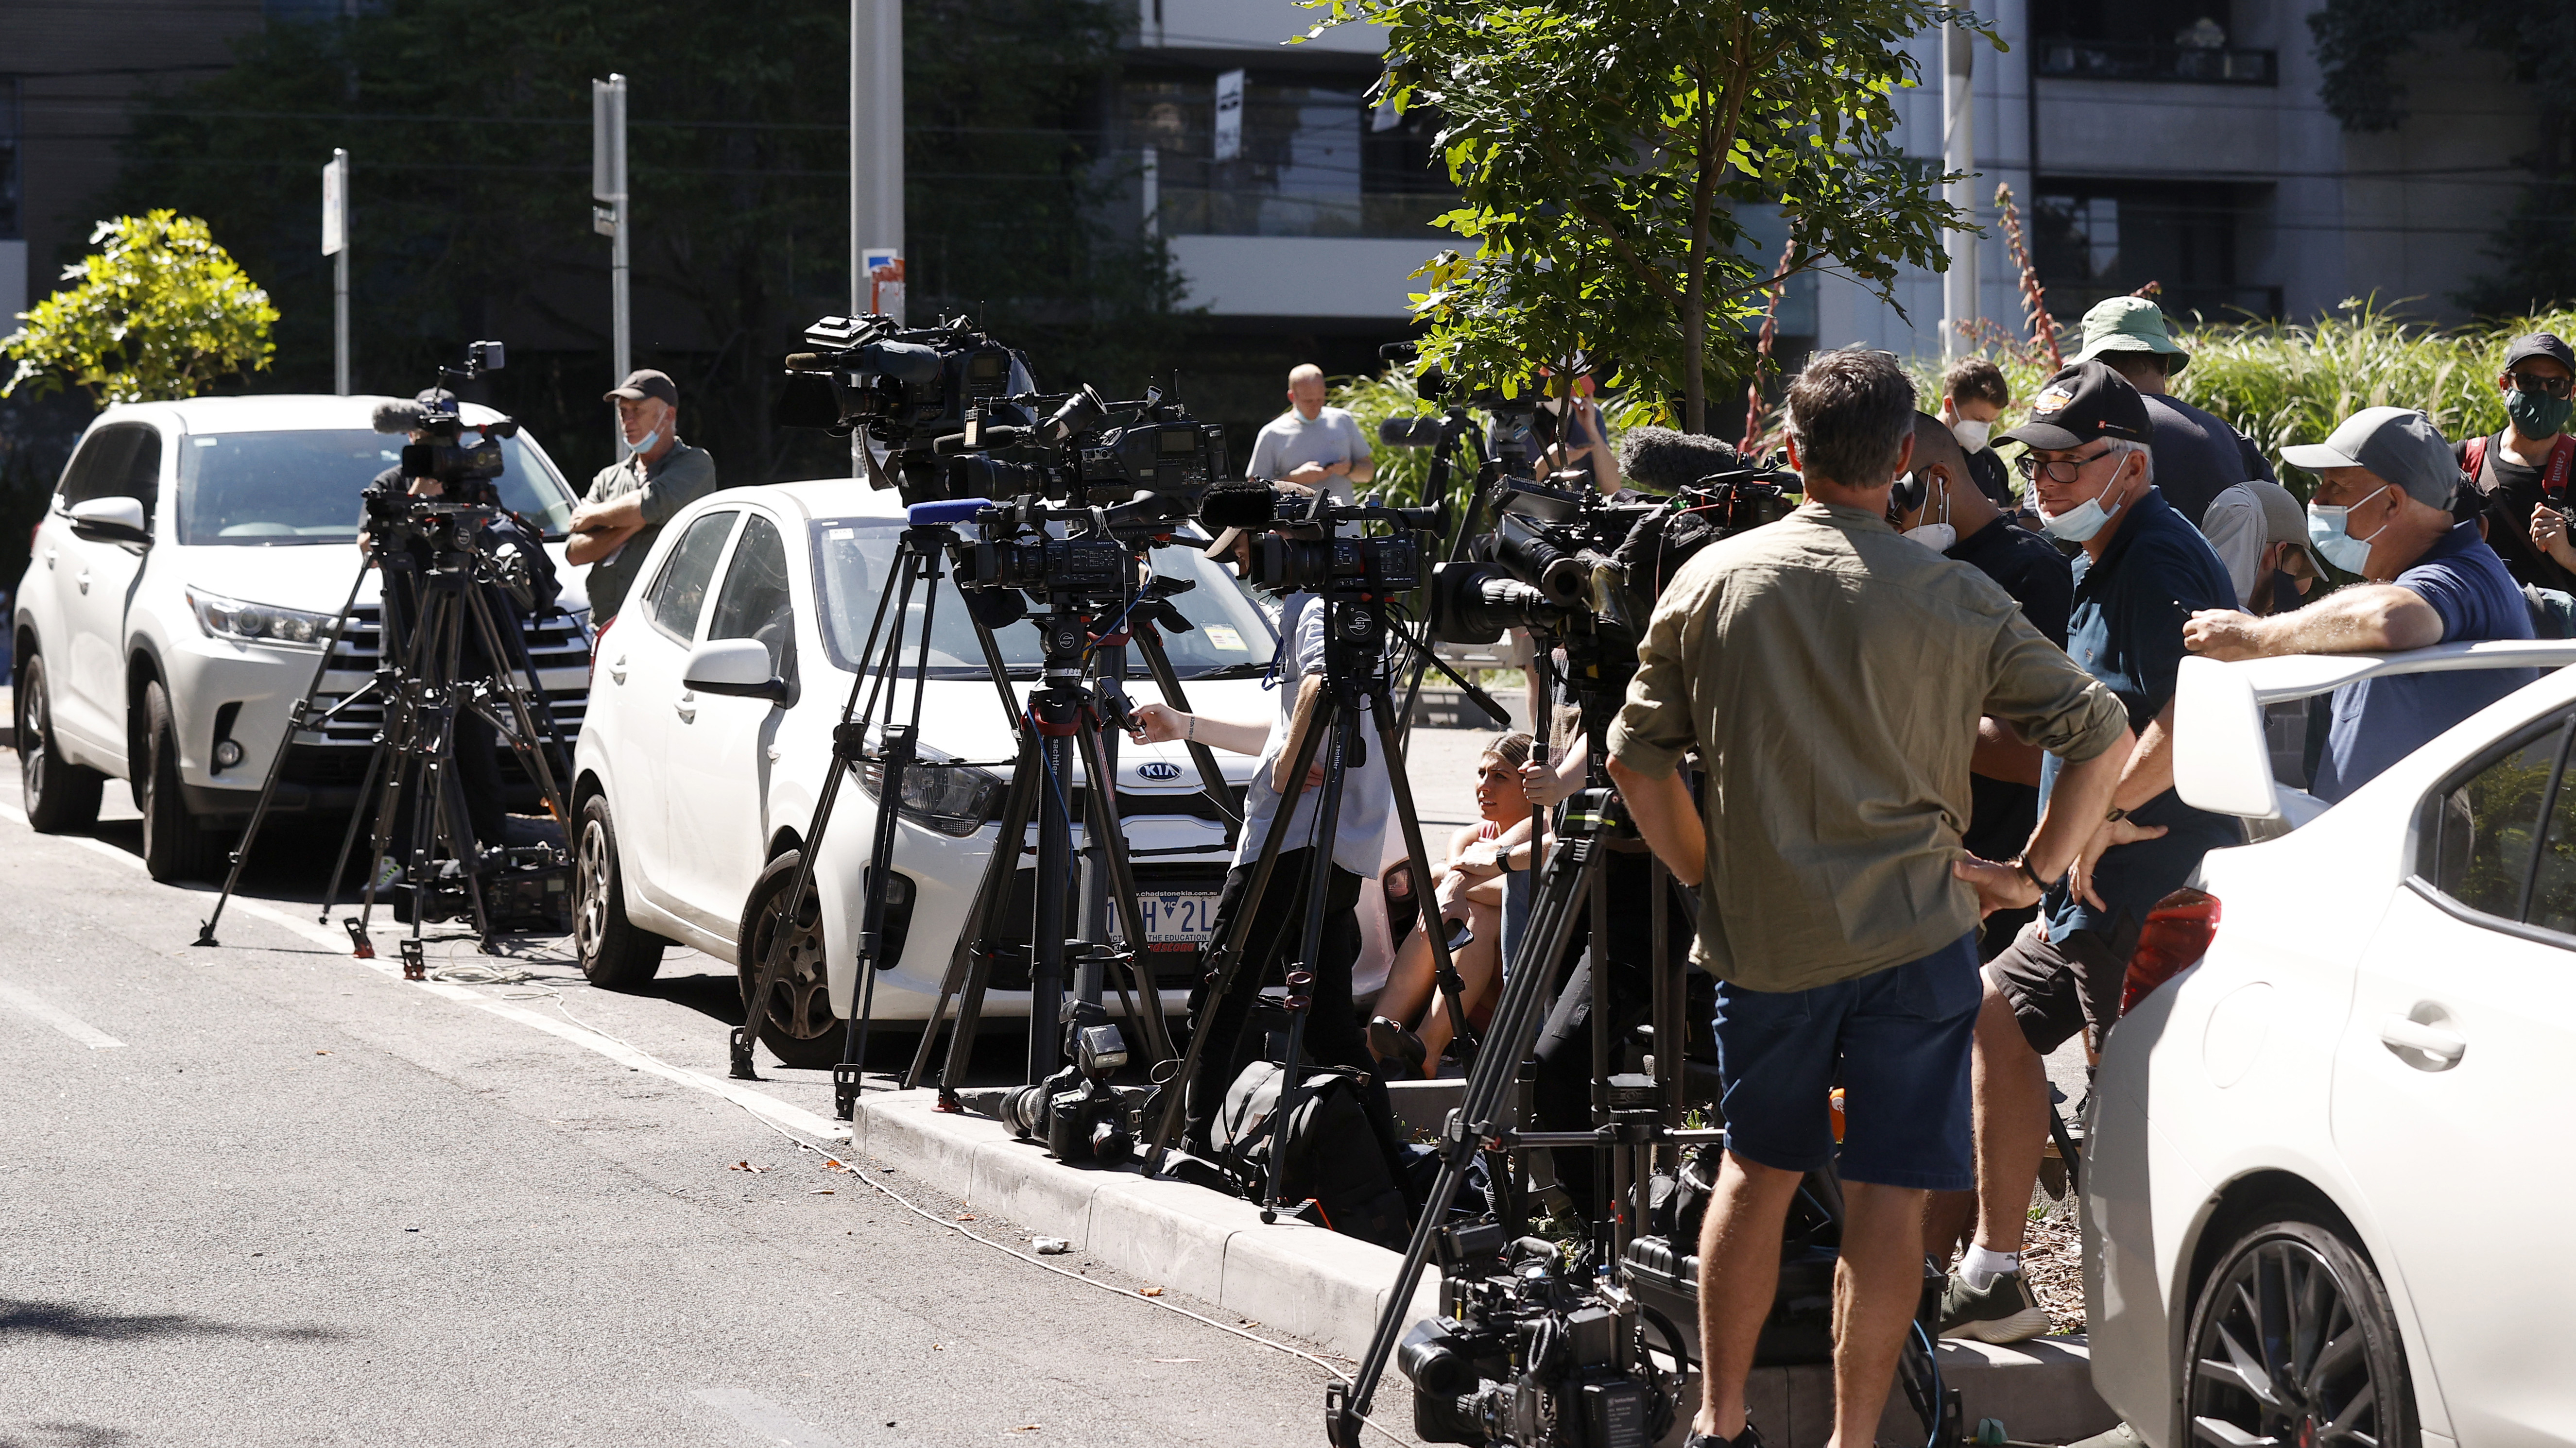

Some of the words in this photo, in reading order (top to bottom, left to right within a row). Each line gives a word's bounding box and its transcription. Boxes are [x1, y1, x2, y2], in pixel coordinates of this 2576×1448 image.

[2552, 450, 2566, 482] Canon
[1051, 738, 1060, 776] sachtler
[1144, 765, 1176, 776] KIA
[1333, 744, 1341, 770] sachtler
[1108, 901, 1156, 933] 1H
[1181, 901, 1212, 932] 2L
[1149, 942, 1195, 953] adstone
